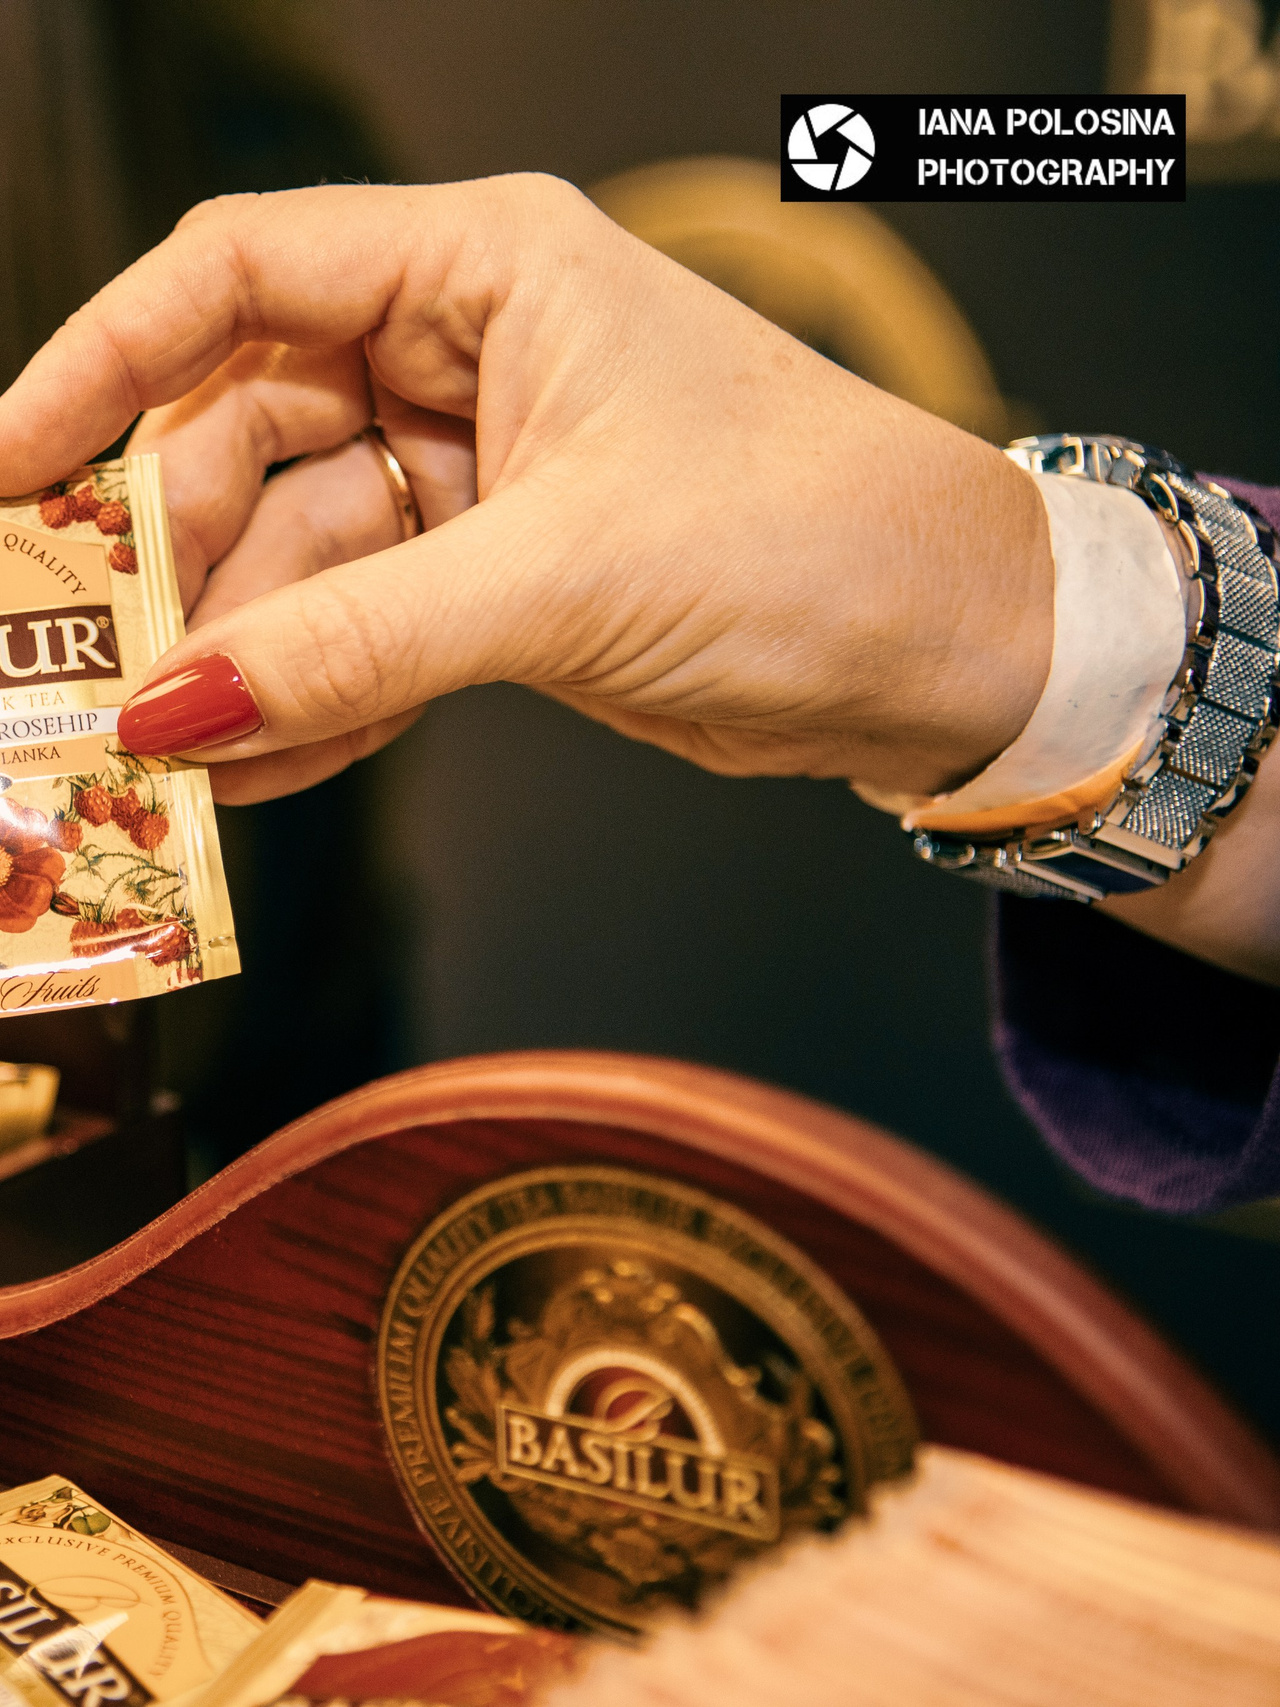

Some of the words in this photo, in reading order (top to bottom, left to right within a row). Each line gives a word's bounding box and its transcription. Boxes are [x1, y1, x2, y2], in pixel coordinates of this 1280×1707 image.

[3, 532, 87, 597] QUALITY
[24, 689, 66, 709] TEA
[1, 745, 62, 766] LANKA
[0, 971, 102, 1011] Fruits
[506, 1415, 766, 1525] BASILUR
[112, 1552, 176, 1606] PREMIUM
